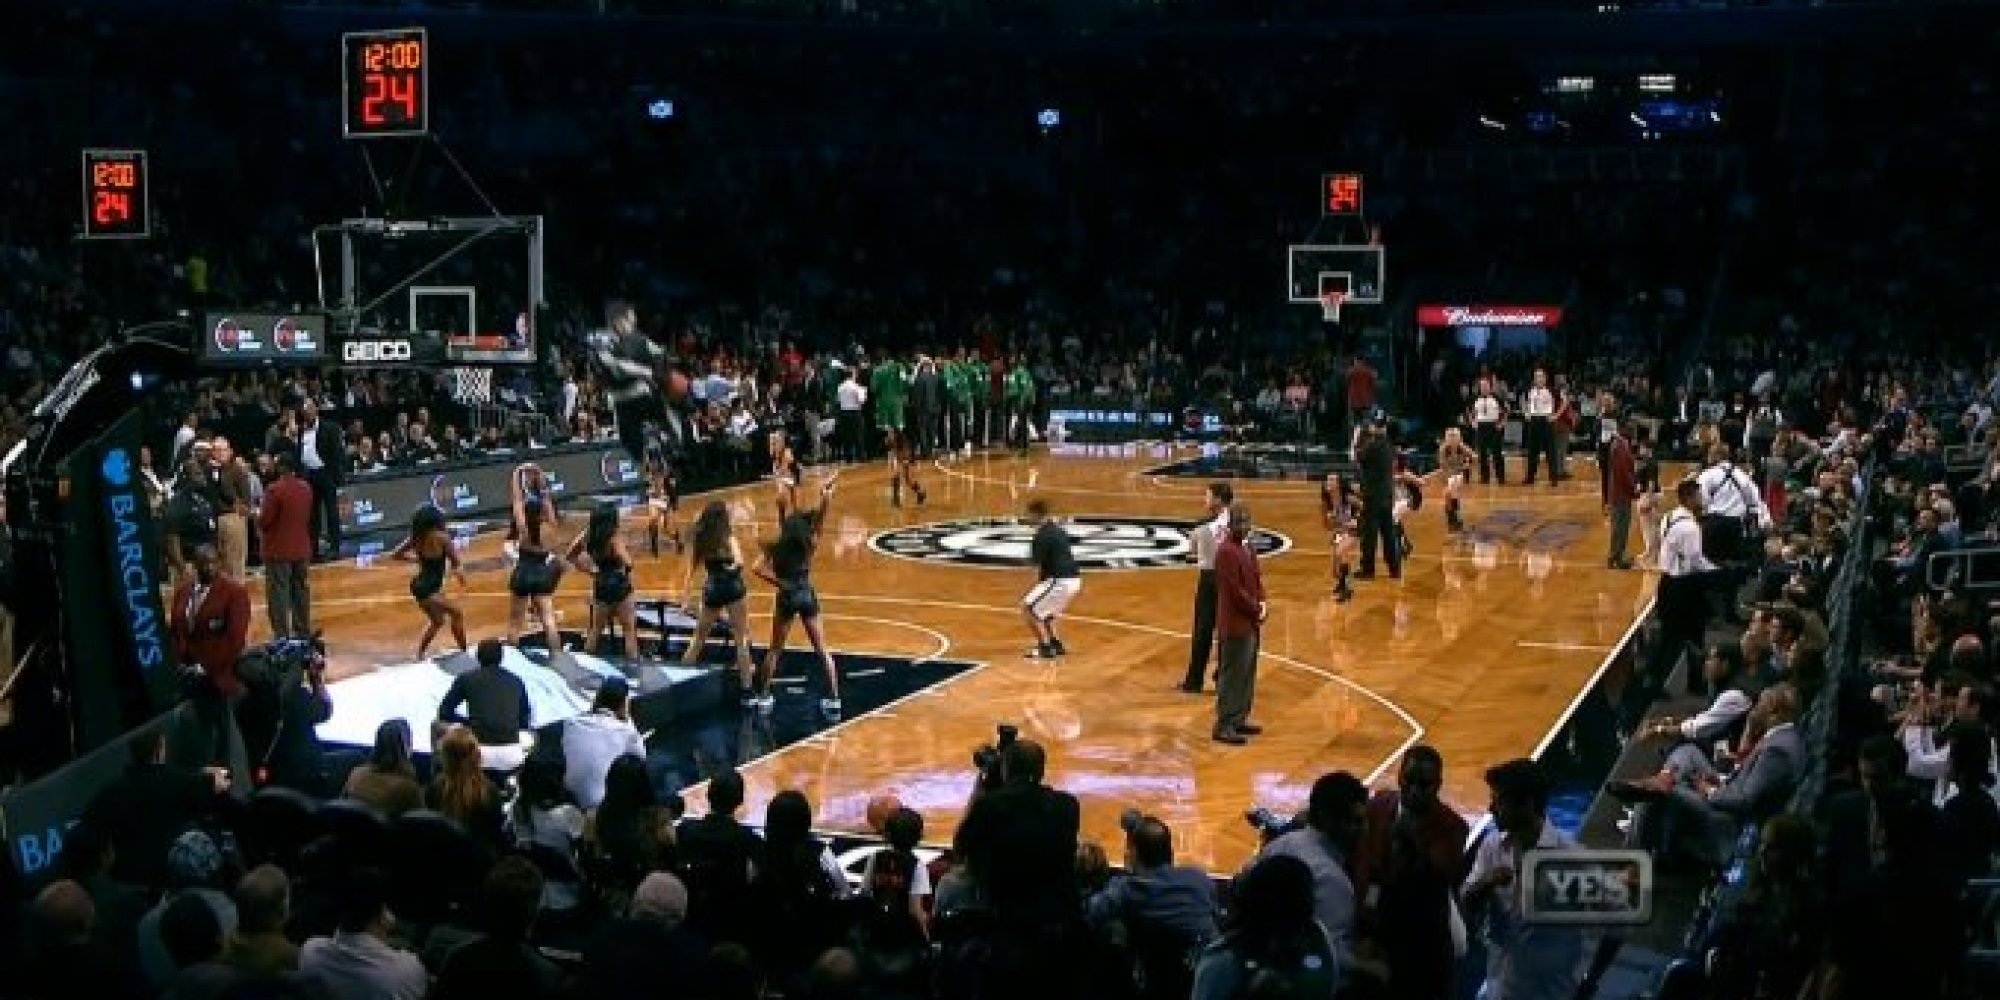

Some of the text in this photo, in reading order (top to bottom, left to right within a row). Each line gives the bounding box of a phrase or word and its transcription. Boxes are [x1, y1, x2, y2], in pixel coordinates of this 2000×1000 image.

[365, 41, 420, 70] 12:00
[364, 74, 414, 122] 24
[93, 162, 134, 187] 12:00
[97, 191, 128, 222] 24
[1442, 307, 1545, 325] Budweiser
[344, 340, 411, 361] GEICO
[111, 494, 163, 665] BARCLAYS
